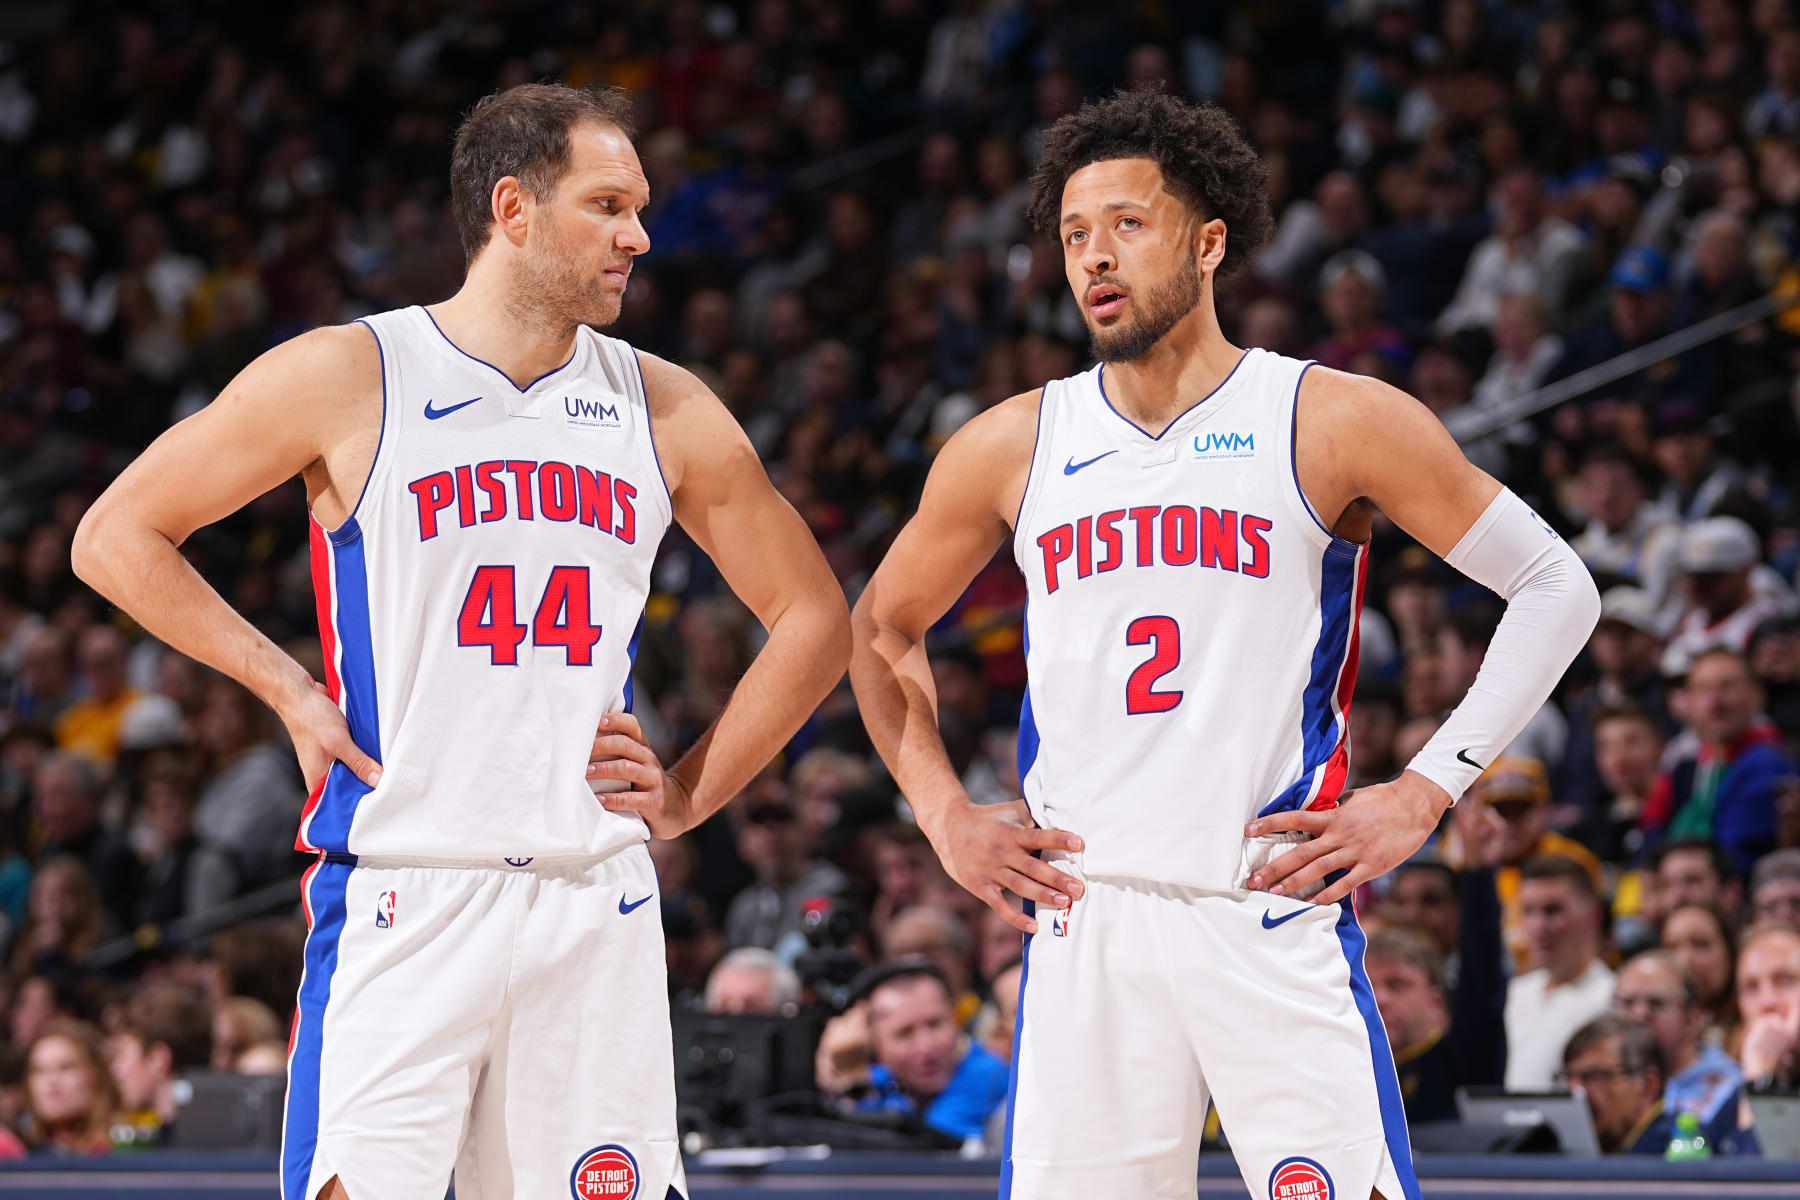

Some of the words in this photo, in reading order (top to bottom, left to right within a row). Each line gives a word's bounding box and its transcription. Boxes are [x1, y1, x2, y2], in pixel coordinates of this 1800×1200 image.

[564, 396, 620, 421] UWM
[1194, 432, 1255, 452] UWM
[408, 459, 638, 545] PISTONS
[1036, 504, 1273, 595] PISTONS
[457, 565, 602, 666] 44
[1126, 615, 1184, 715] 2
[585, 1181, 629, 1194] PISTONS
[586, 1169, 628, 1182] DETROIT
[1279, 1180, 1318, 1196] DETROIT
